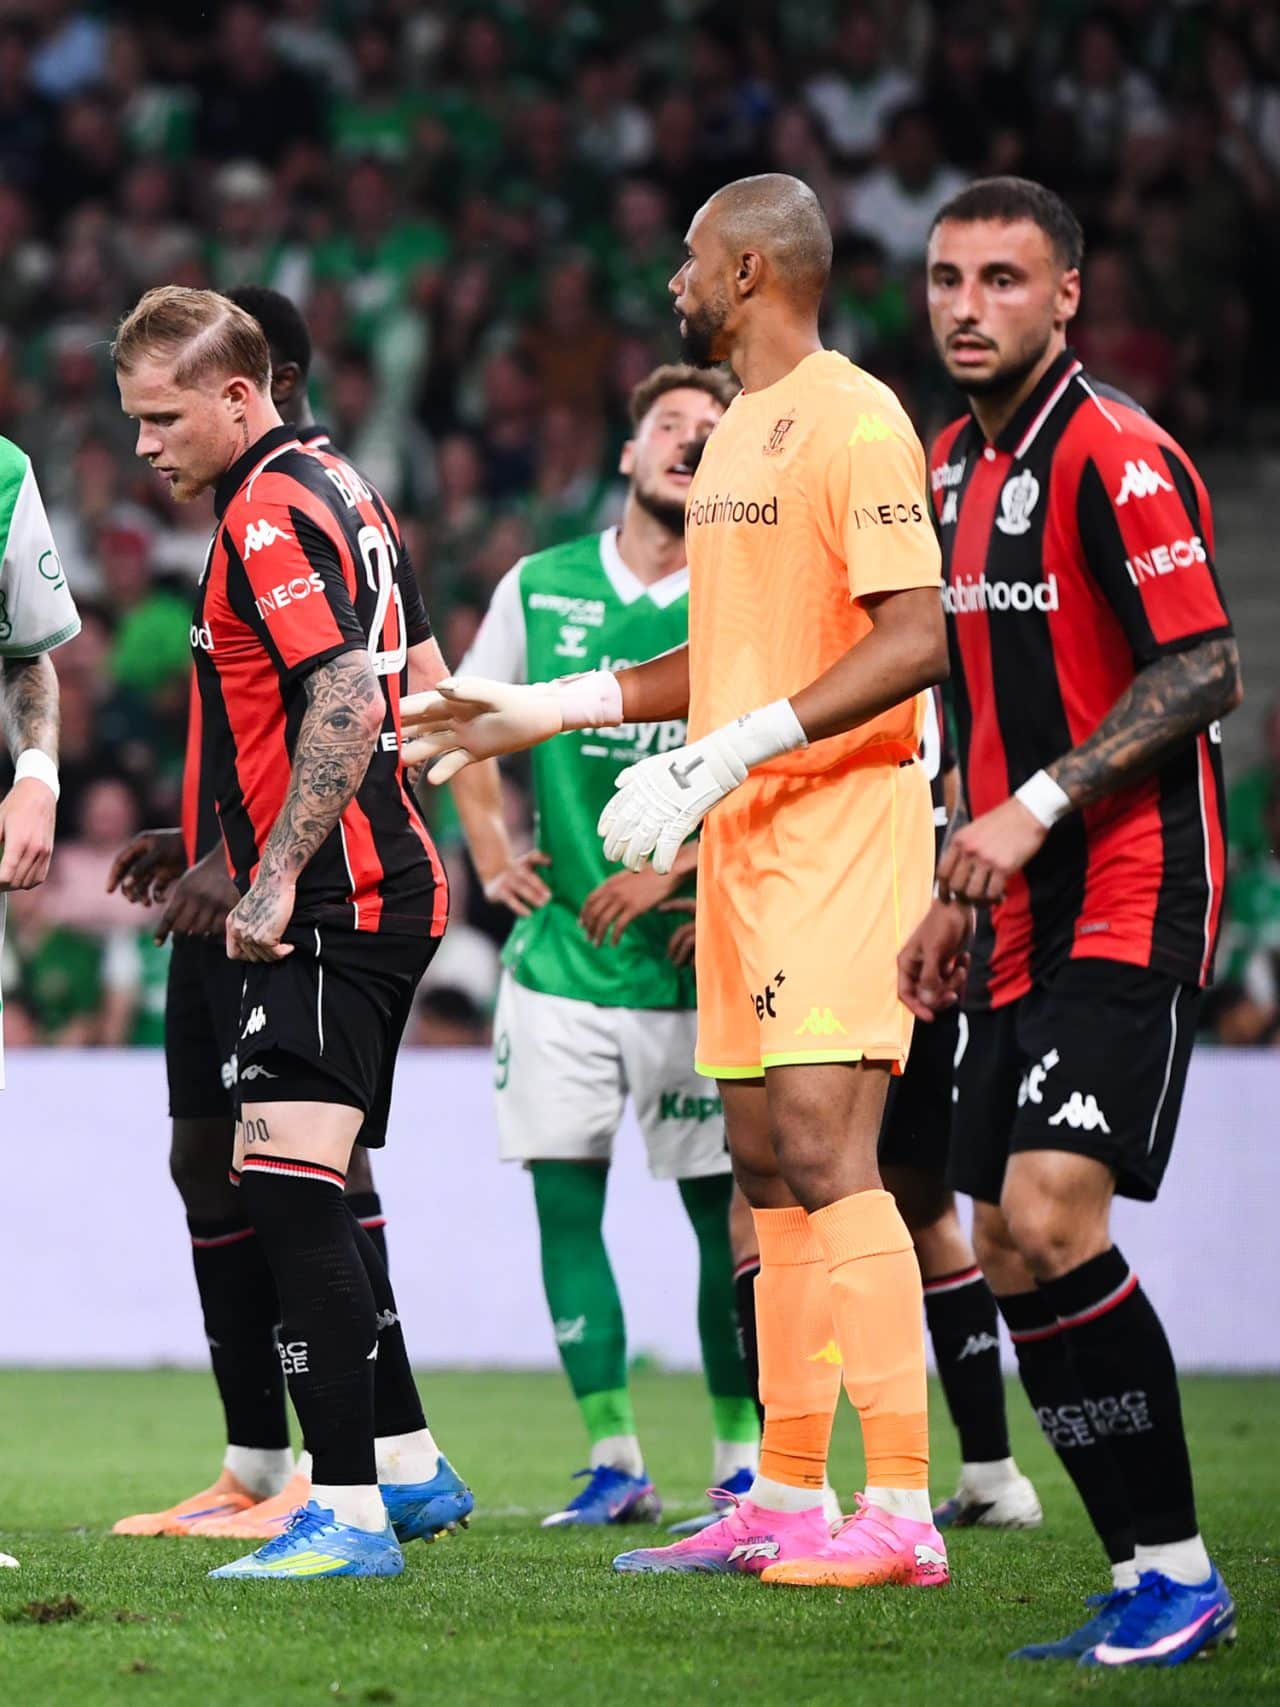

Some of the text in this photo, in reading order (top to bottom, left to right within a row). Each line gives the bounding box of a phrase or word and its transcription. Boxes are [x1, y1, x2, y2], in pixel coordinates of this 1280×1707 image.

[853, 504, 922, 529] INEOS
[1124, 536, 1207, 587] INEOS
[254, 572, 326, 620] INEOS
